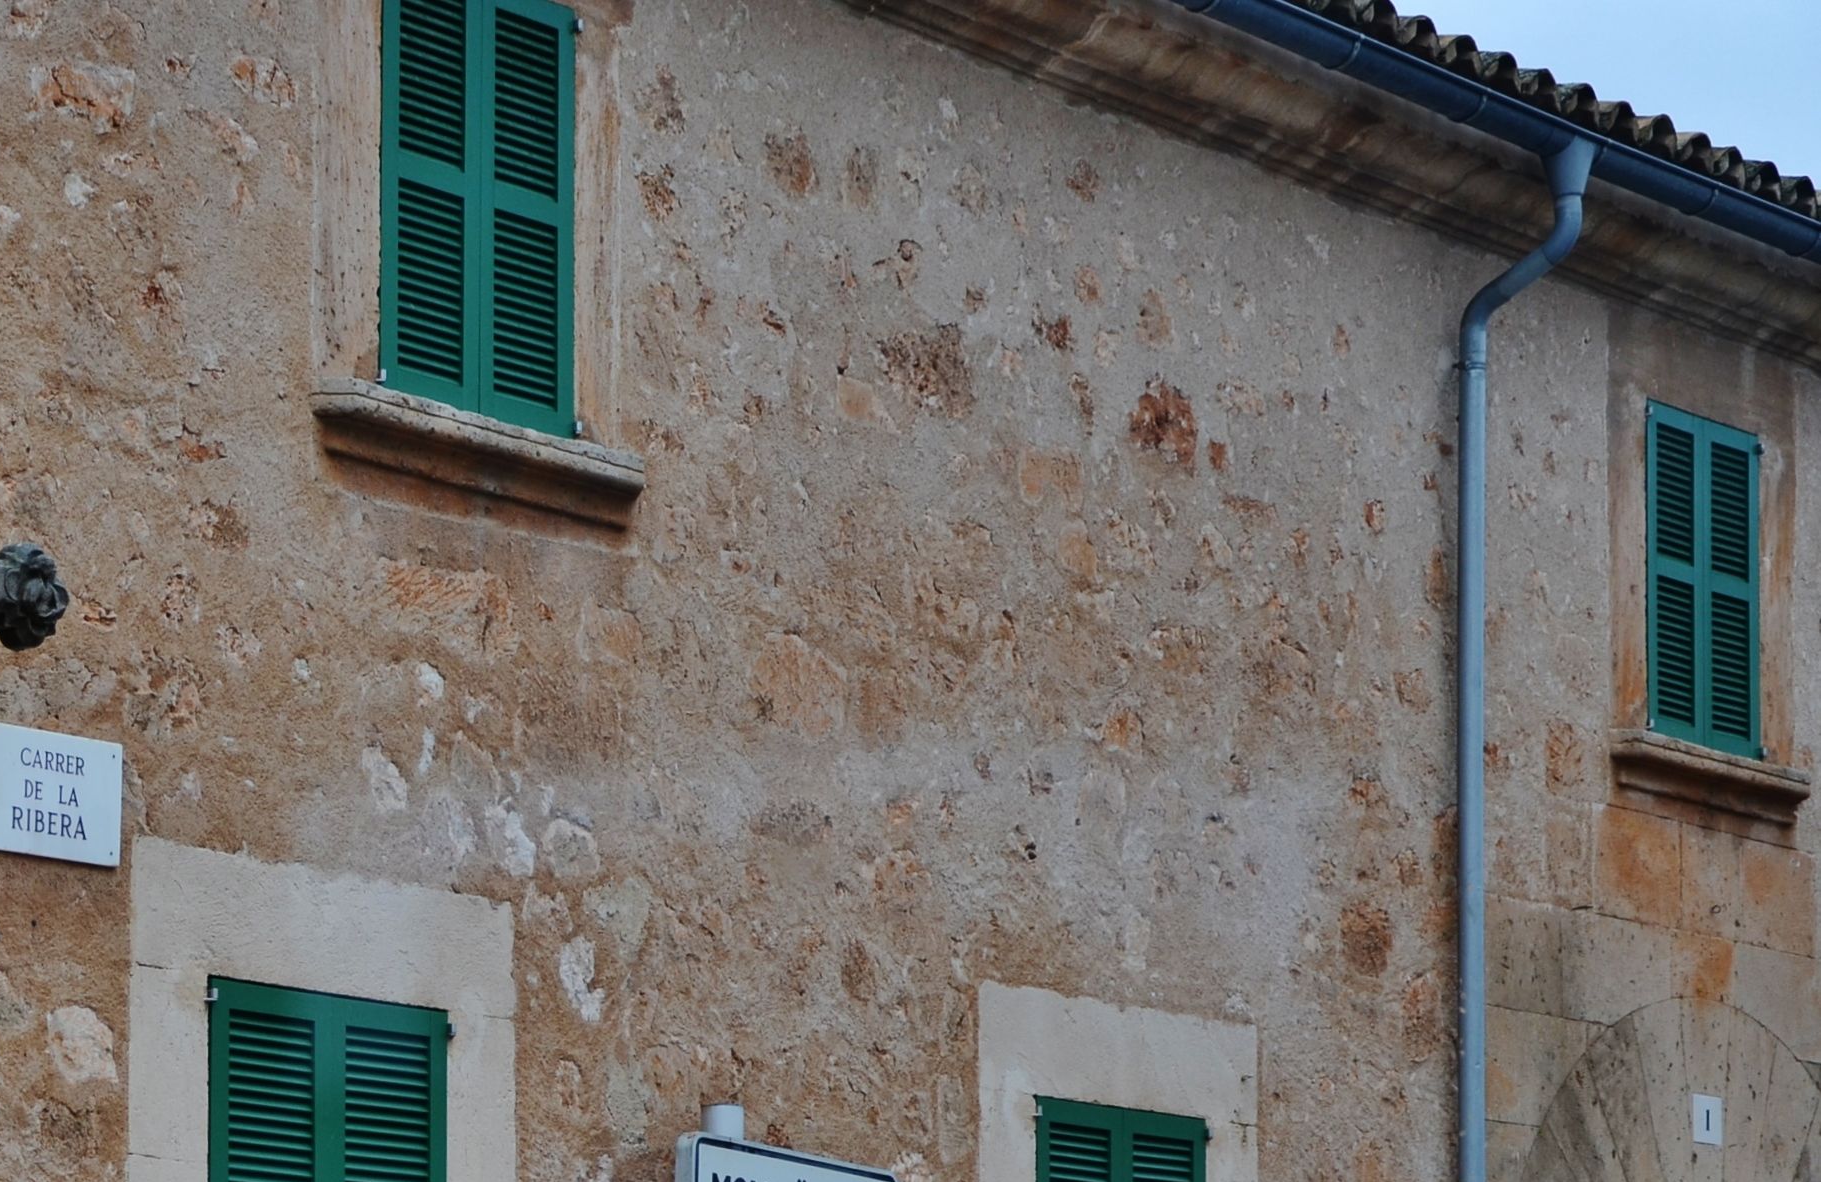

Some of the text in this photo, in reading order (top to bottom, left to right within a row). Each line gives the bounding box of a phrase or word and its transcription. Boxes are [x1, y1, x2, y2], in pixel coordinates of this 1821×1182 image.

[20, 747, 85, 776] CARRER
[24, 779, 79, 807] DE LA
[12, 806, 87, 840] RIBERA
